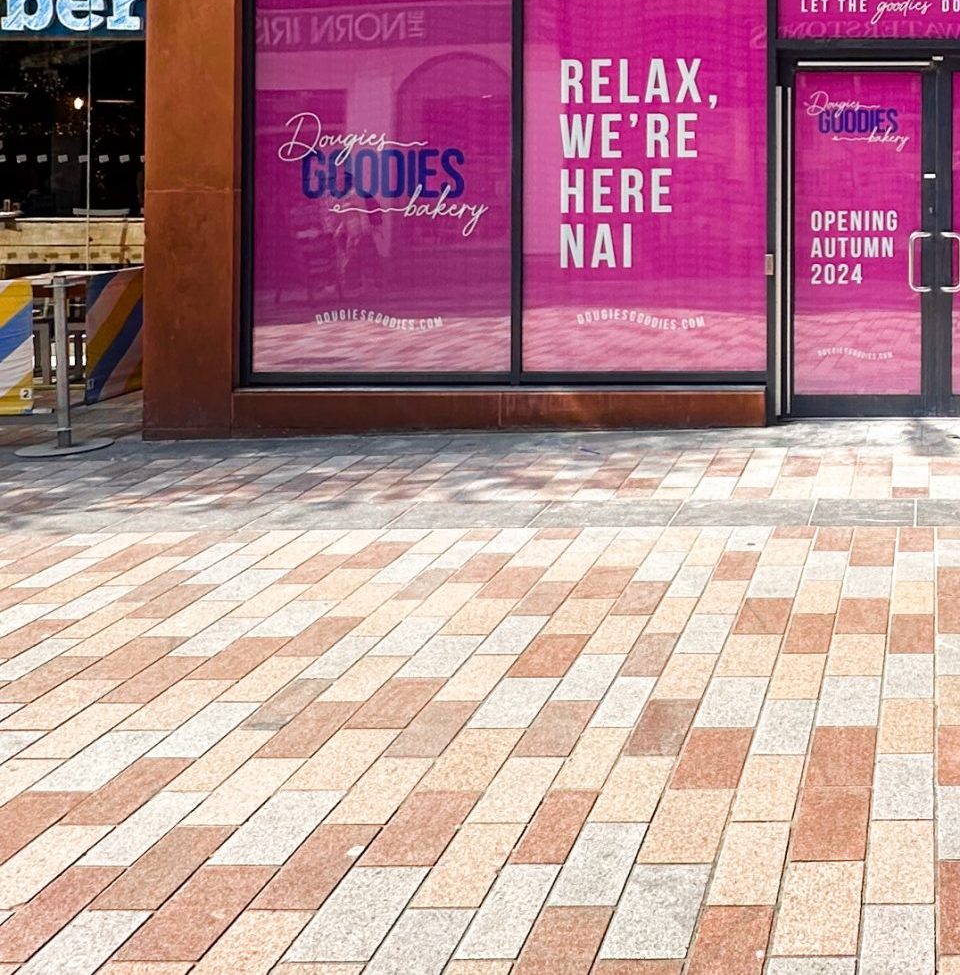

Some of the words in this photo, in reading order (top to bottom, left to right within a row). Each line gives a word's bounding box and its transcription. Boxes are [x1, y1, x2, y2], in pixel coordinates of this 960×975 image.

[560, 58, 718, 109] RELAX,
[807, 91, 880, 118] Dougies
[818, 108, 898, 133] GOODIES
[278, 112, 428, 166] Dougies
[559, 113, 699, 159] WE'RE
[832, 126, 910, 152] bakery
[302, 148, 465, 199] GOODIES
[560, 168, 673, 214] HERE
[328, 183, 489, 237] bakery
[811, 210, 898, 233] OPENING
[560, 223, 633, 269] NAI
[810, 237, 894, 258] AUTUMN
[811, 263, 864, 285] 2024
[315, 308, 443, 330] DOUGIESGOODIES.COM
[576, 308, 705, 331] DOUGIESGOODIES.COM
